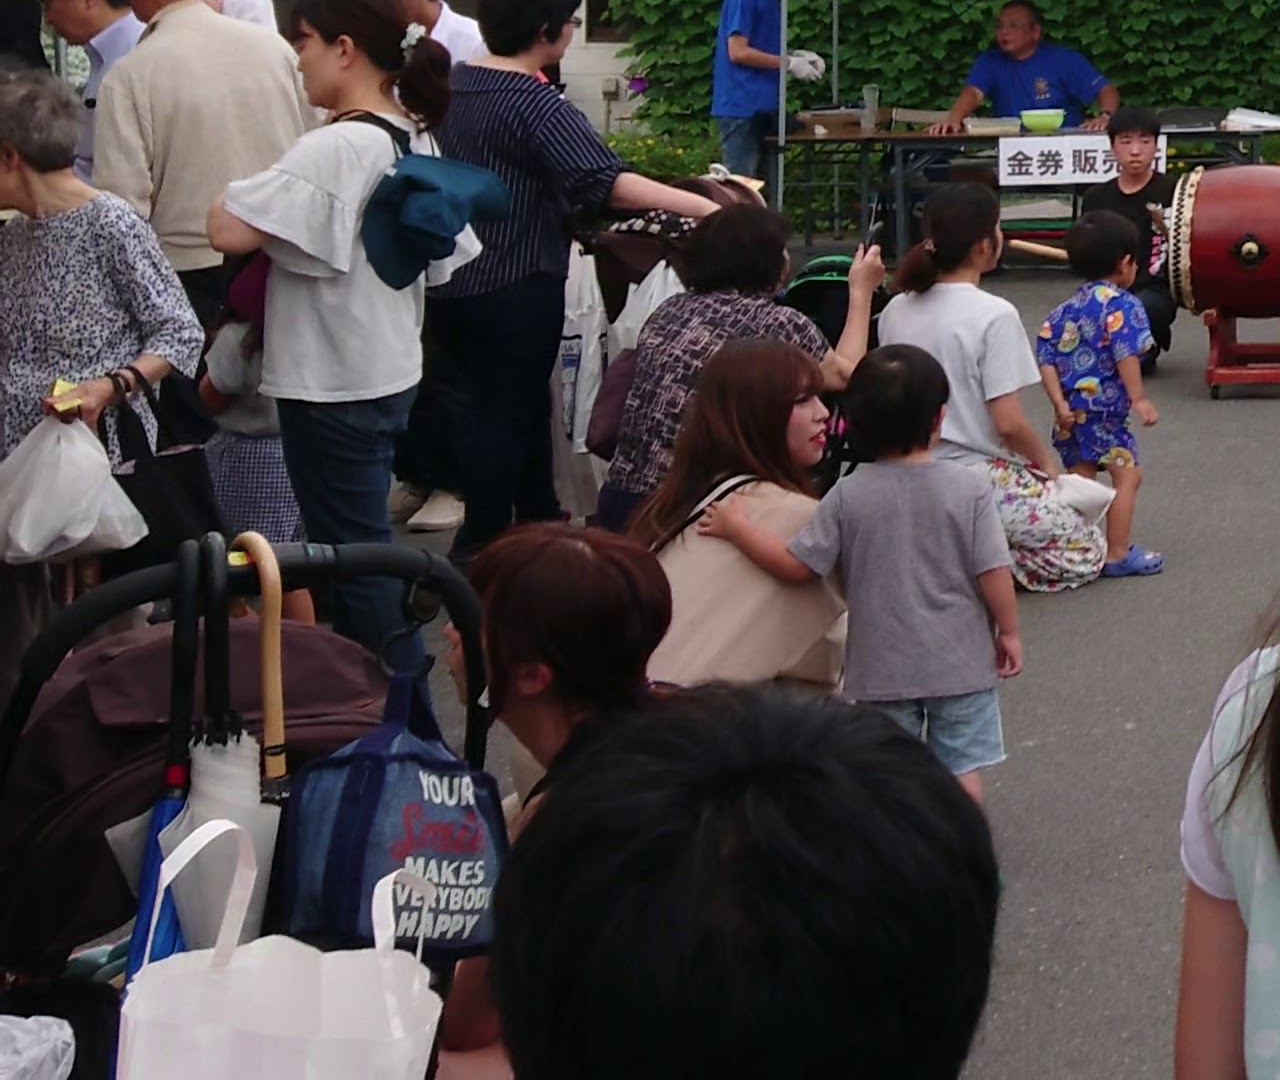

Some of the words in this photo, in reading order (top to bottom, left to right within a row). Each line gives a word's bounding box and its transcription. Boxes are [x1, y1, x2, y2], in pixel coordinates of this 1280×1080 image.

[1007, 150, 1064, 176] 金券
[419, 771, 475, 806] YOUR
[405, 856, 484, 886] MAKES
[396, 911, 480, 939] HAPPY
